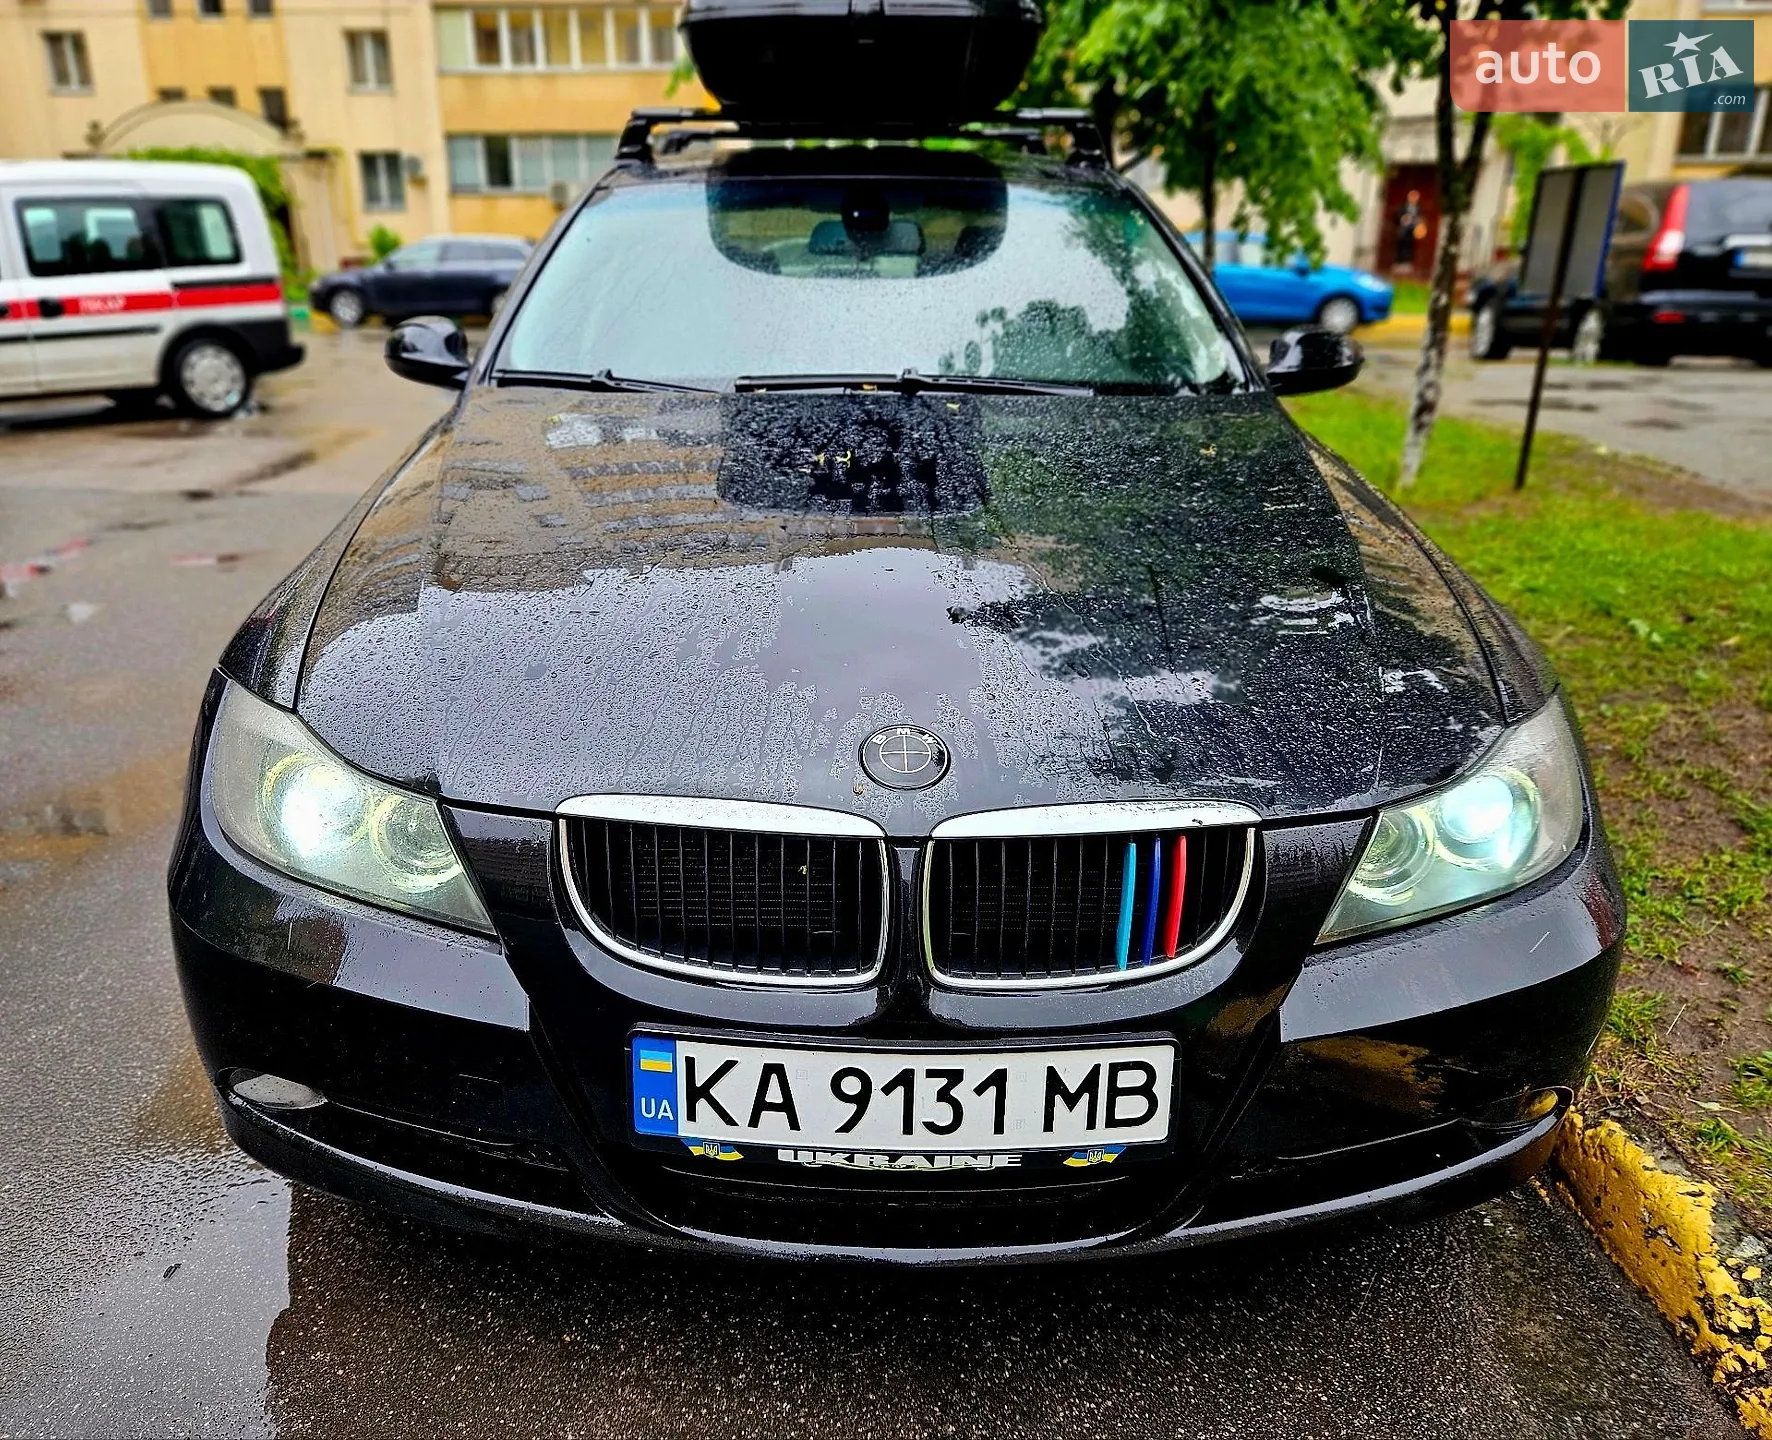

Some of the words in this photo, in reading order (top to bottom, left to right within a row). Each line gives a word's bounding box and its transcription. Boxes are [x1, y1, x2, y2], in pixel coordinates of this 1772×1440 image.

[871, 728, 938, 745] BMW
[684, 1055, 801, 1132] KA
[829, 1066, 1008, 1136] 9131
[1042, 1060, 1158, 1134] MB
[641, 1097, 674, 1121] UA
[777, 1149, 1023, 1168] UKRAINE
